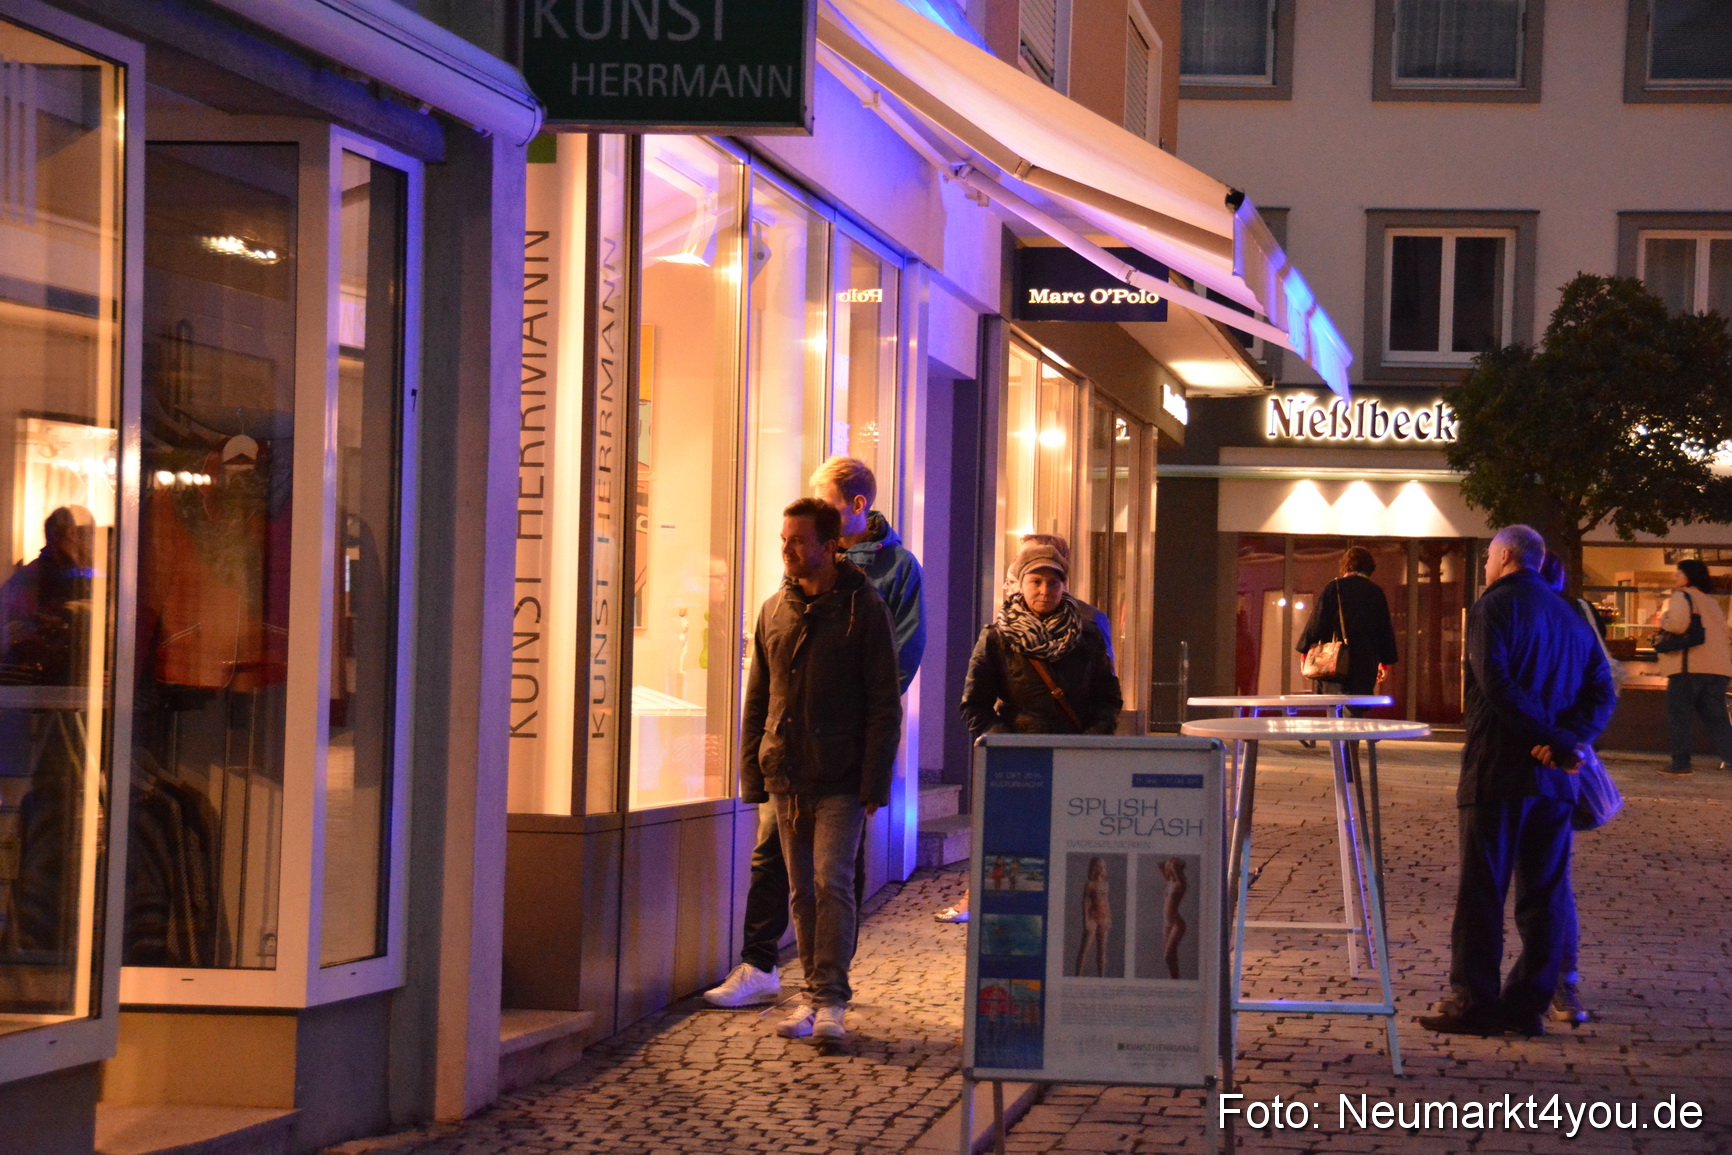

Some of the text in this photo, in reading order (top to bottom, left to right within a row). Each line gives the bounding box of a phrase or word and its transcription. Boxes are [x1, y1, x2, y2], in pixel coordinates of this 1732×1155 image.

[532, 0, 724, 41] KUNST
[570, 62, 793, 98] HERRMANN
[1028, 288, 1160, 304] Marc O'Polo
[1267, 397, 1458, 440] Nießlbeck
[592, 236, 617, 738] KUNST HERRMANN
[1067, 797, 1158, 817] SPLISH
[1098, 816, 1204, 837] SPLASH
